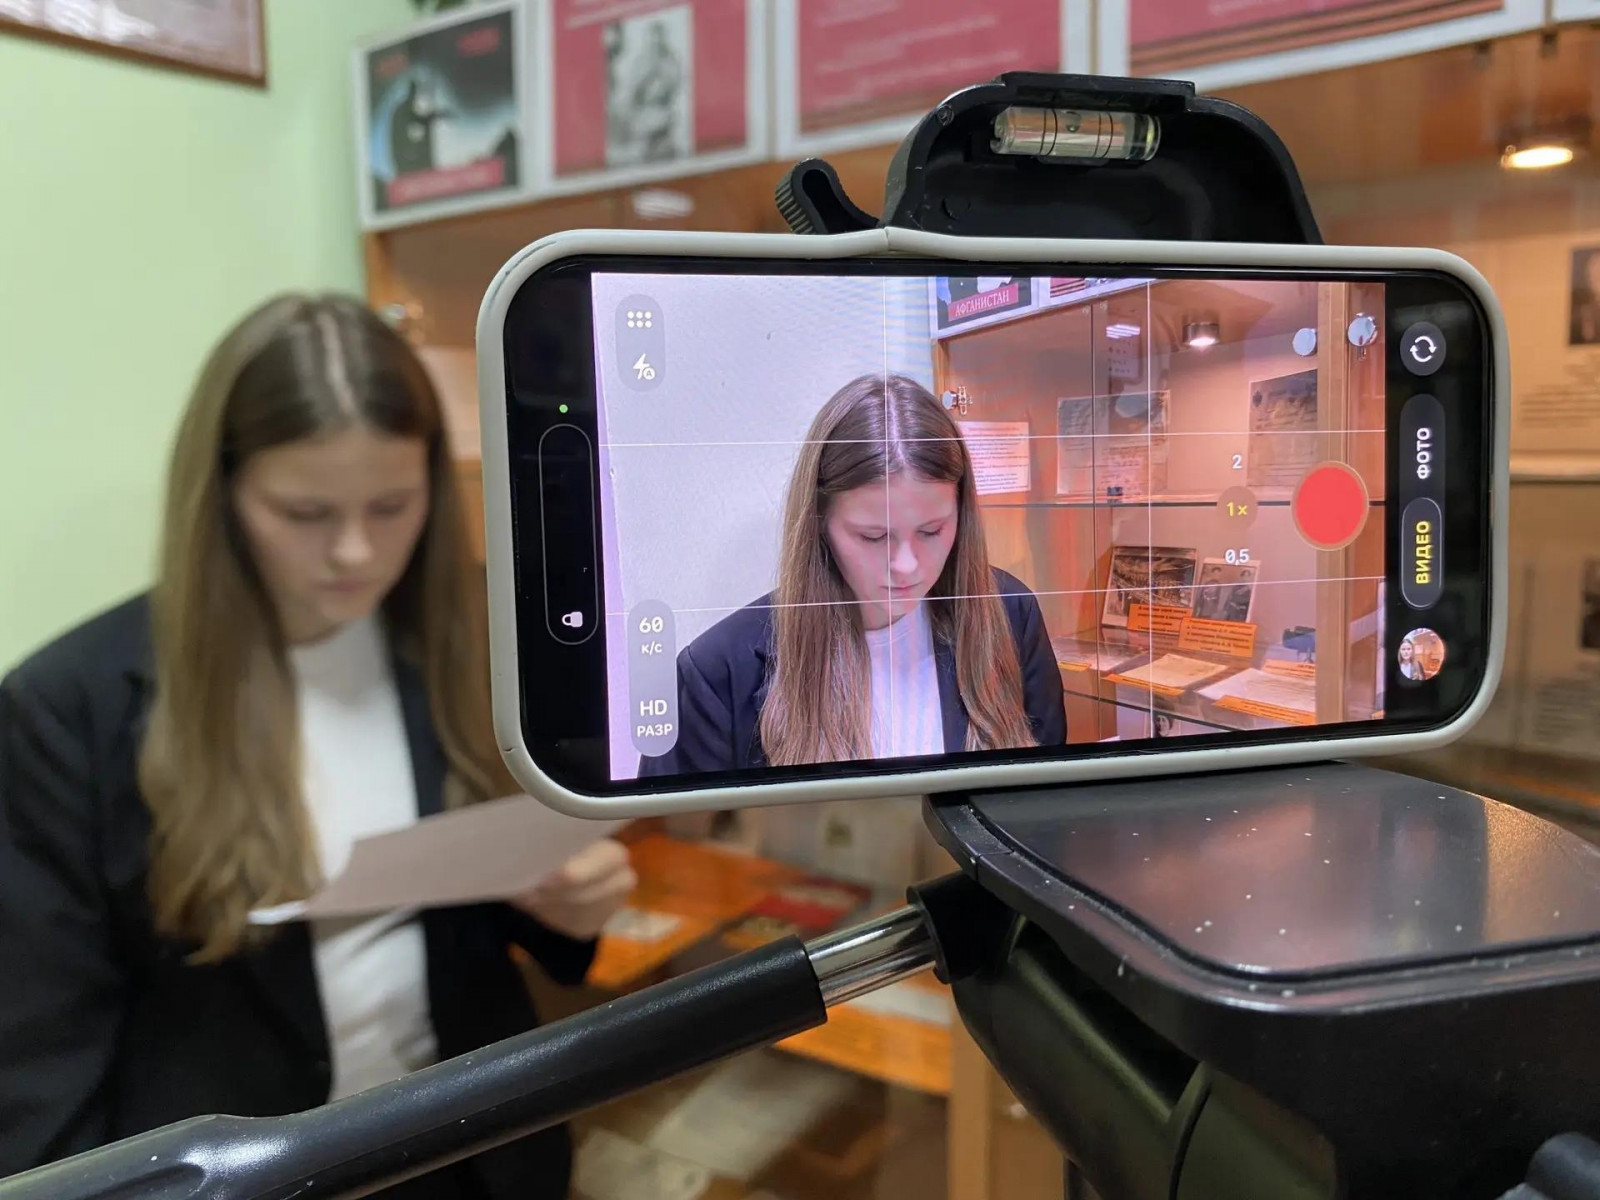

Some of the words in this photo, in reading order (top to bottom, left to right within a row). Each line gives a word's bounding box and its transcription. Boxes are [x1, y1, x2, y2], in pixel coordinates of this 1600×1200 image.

[955, 289, 1010, 317] АФГАНИСТАН
[1232, 454, 1243, 469] 2
[1416, 427, 1432, 480] ФОТО
[1225, 548, 1250, 566] 0,5
[1415, 520, 1434, 585] ВИДЕО
[639, 616, 664, 634] 60
[639, 700, 668, 717] HD
[636, 723, 673, 738] РАЗР
